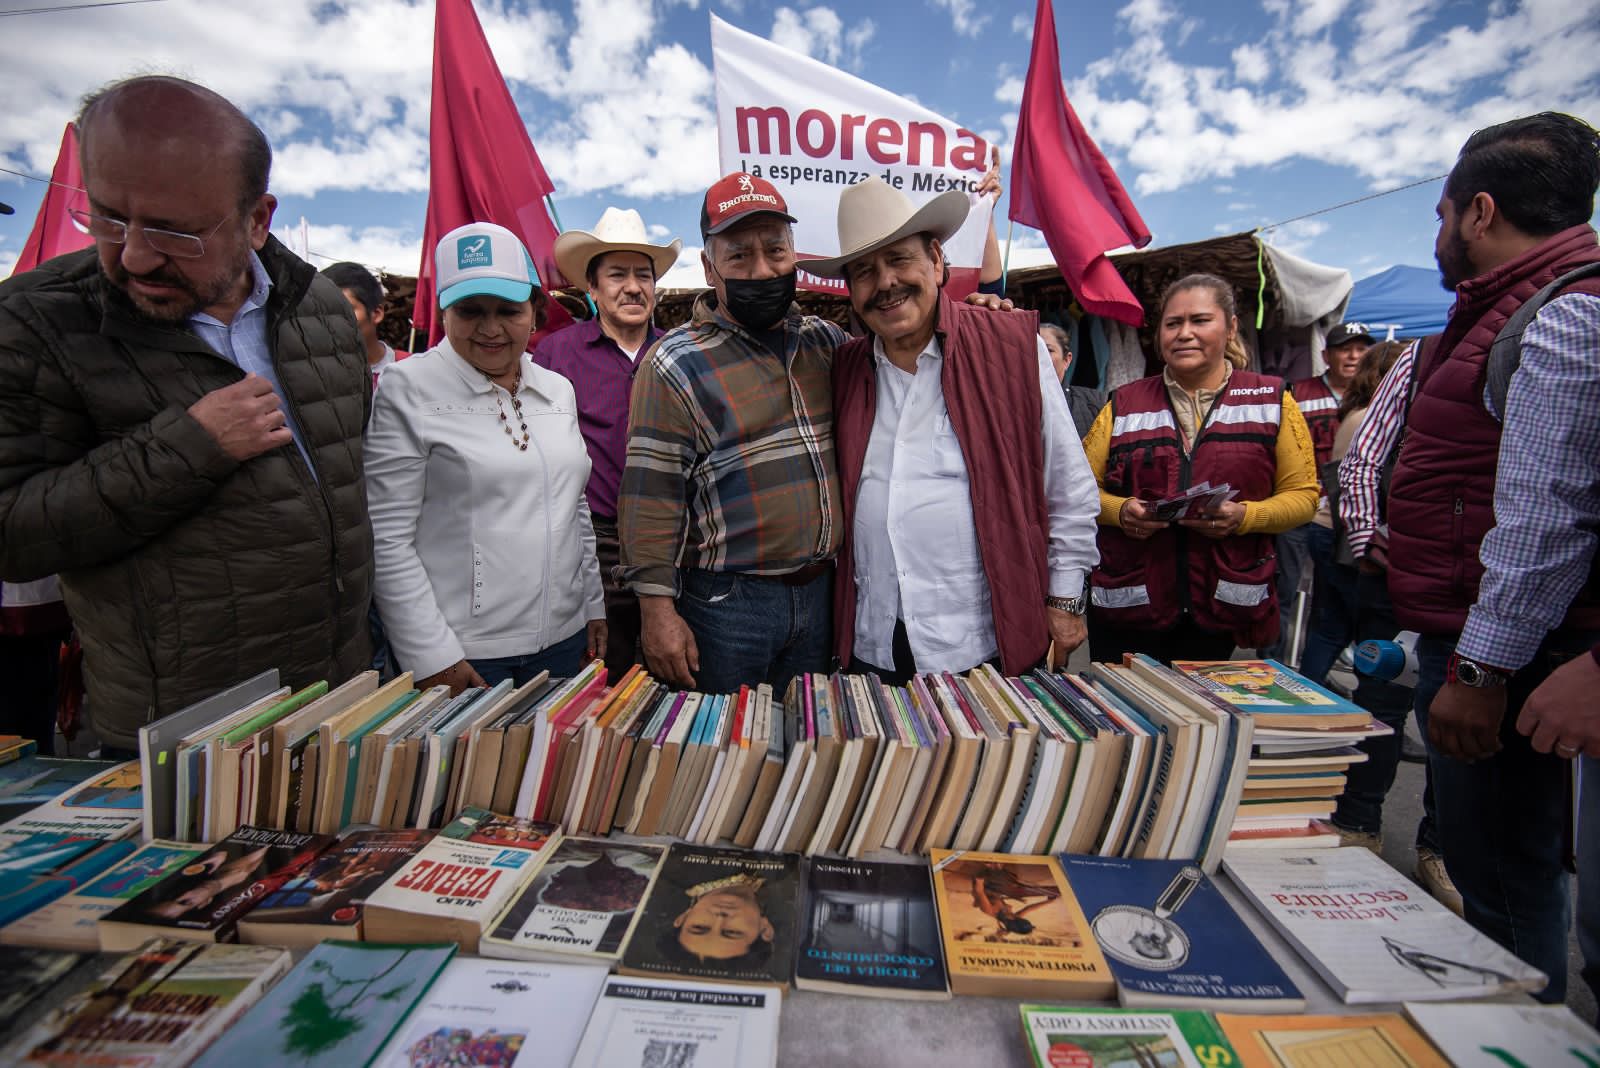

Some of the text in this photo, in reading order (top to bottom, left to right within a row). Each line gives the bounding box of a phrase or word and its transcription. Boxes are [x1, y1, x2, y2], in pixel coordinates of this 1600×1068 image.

[735, 106, 988, 172] morena
[880, 169, 904, 190] de
[912, 173, 979, 193] Méxic
[718, 193, 777, 213] BROWNING
[1229, 385, 1275, 397] morena
[1156, 743, 1173, 795] MIGUEL
[1140, 800, 1158, 843] ANGEL
[394, 859, 503, 899] VERNE
[436, 896, 483, 908] JULIO
[1270, 890, 1409, 907] escritura
[1311, 906, 1399, 922] lectura
[524, 931, 593, 946] MARIANELA
[807, 949, 935, 967] CONOCIMIENTO
[959, 956, 1025, 969] NACIONAL
[823, 963, 851, 975] DEL
[1026, 960, 1097, 973] PINOTEPA
[616, 986, 649, 998] libres
[1137, 980, 1207, 995] RESCATE
[1229, 985, 1284, 996] ESPIAS
[699, 992, 739, 1004] verdad
[741, 995, 757, 1005] La
[1032, 1015, 1172, 1031] ANTHONY GREY
